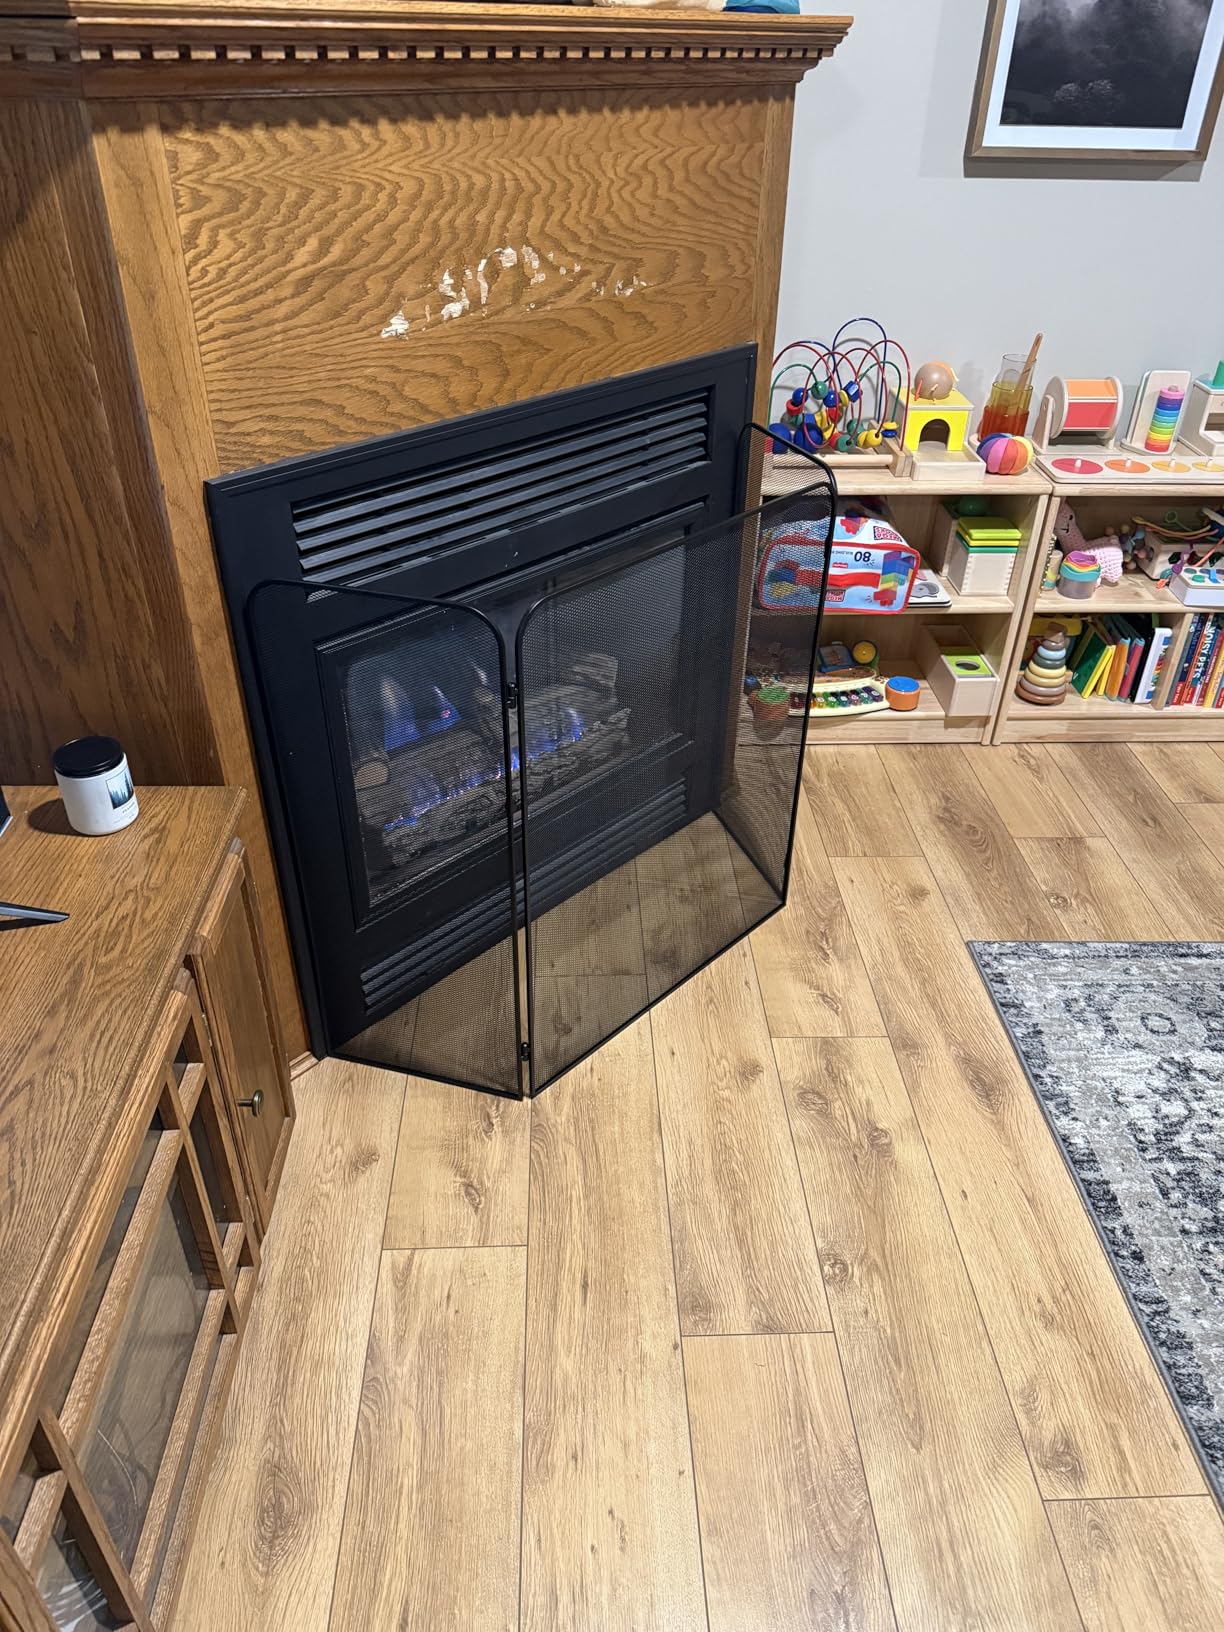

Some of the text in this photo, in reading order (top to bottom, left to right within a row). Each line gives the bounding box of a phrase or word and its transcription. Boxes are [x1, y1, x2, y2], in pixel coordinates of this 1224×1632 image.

[854, 551, 872, 562] 80
[1201, 626, 1216, 654] NOISY
[1193, 657, 1206, 678] PETS
